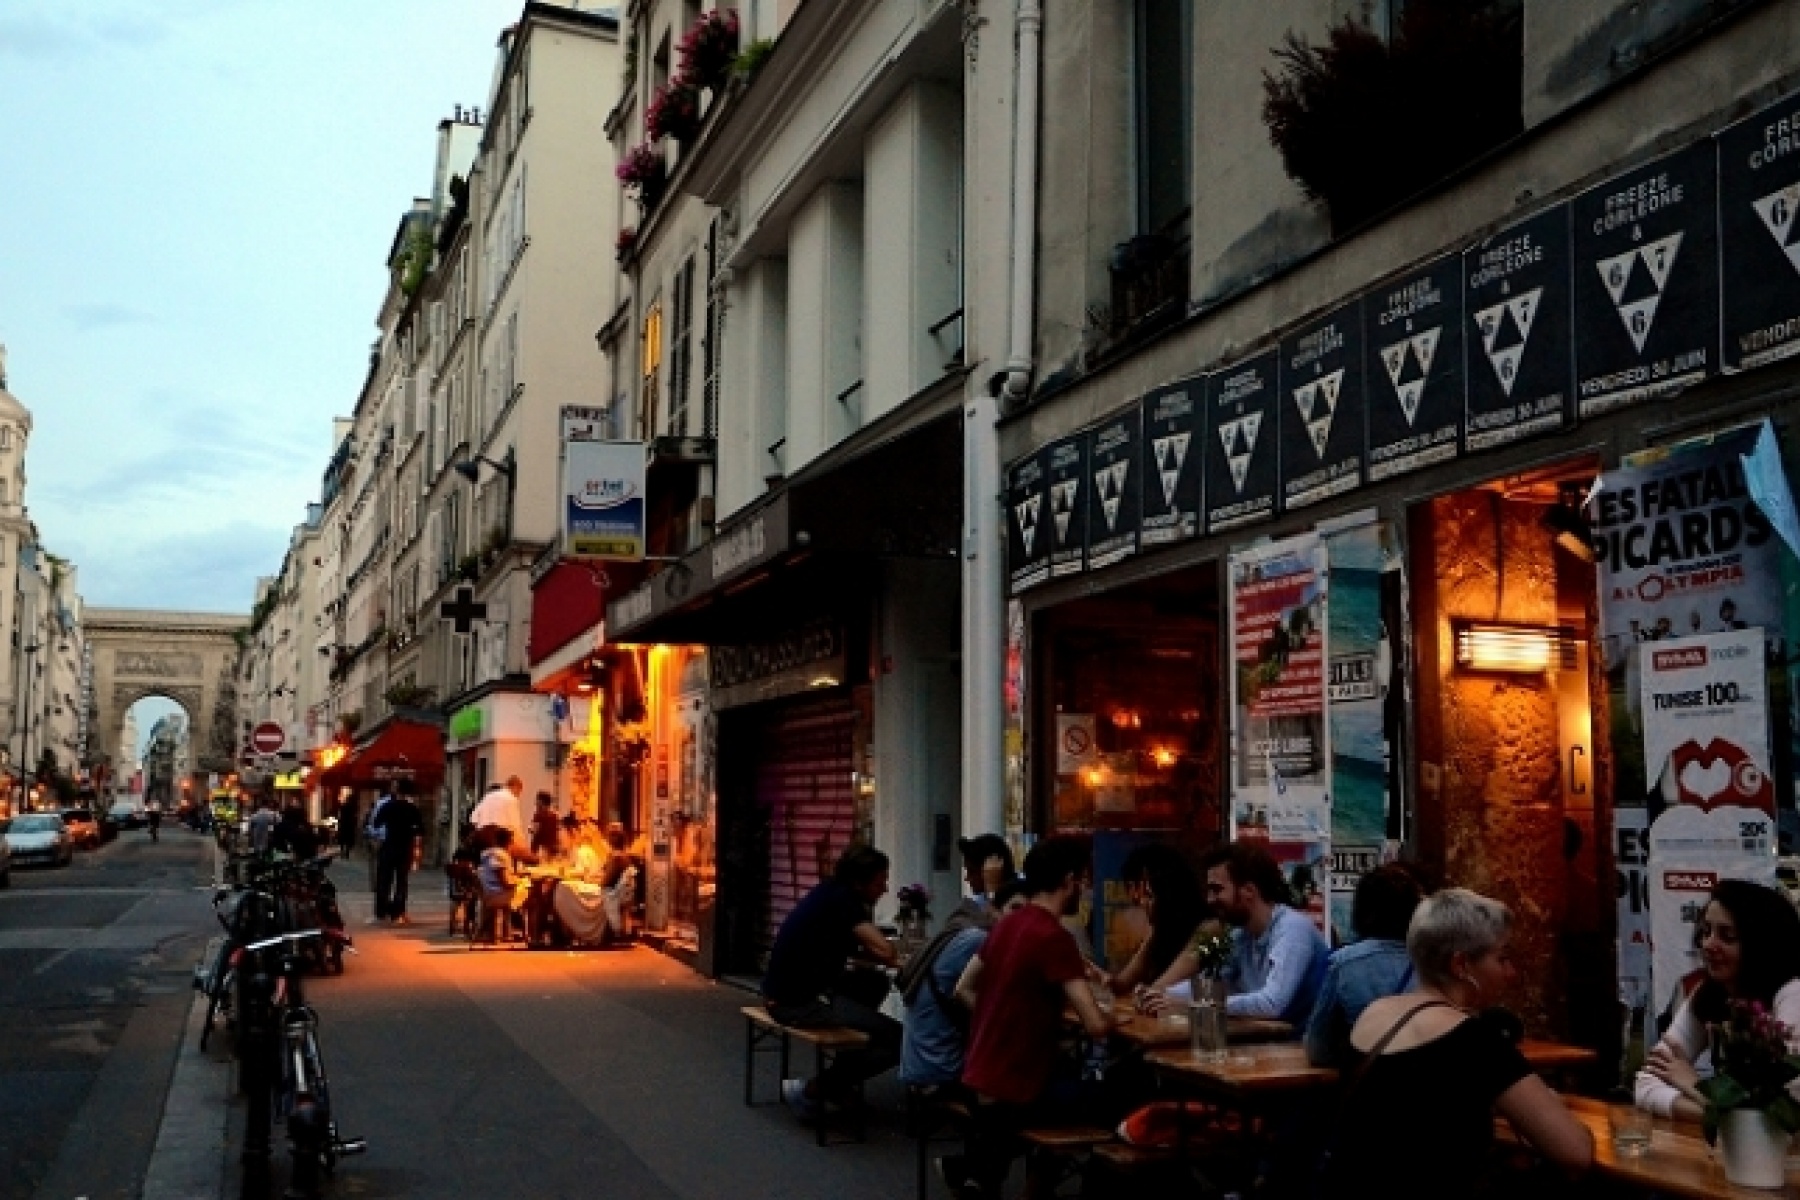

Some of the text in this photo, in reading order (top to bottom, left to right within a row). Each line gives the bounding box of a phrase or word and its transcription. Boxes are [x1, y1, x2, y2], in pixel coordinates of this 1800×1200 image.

[1592, 183, 1685, 236] CORLEONE
[1604, 172, 1669, 210] FREEZE
[1470, 245, 1544, 289] CORLEONE
[1631, 309, 1646, 335] 6
[1738, 316, 1800, 353] VENDR
[1579, 365, 1650, 396] VENDREDI
[1671, 346, 1707, 375] JUIN
[1591, 500, 1771, 574] PICARDS
[1705, 681, 1740, 706] 100
